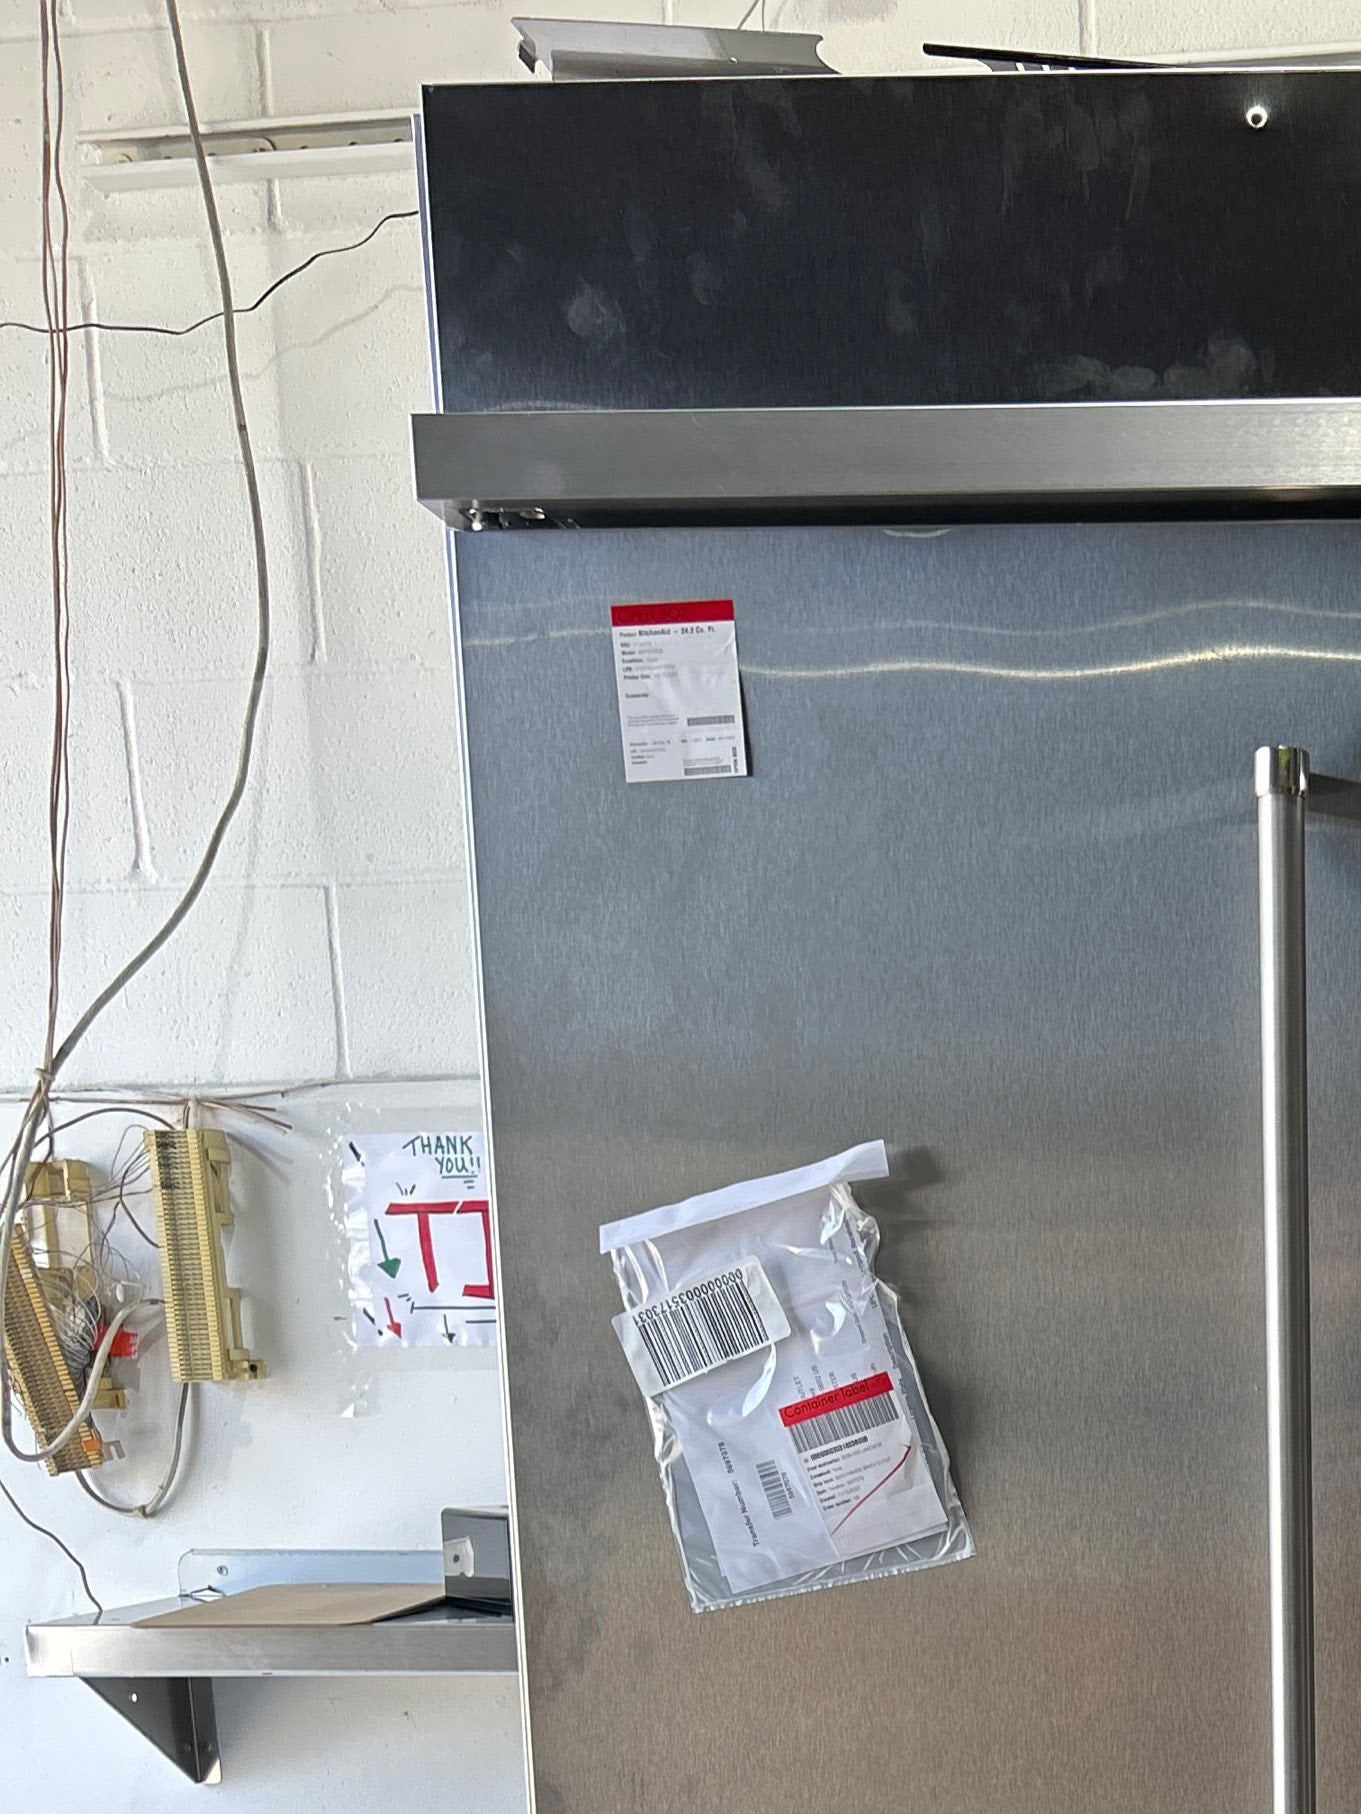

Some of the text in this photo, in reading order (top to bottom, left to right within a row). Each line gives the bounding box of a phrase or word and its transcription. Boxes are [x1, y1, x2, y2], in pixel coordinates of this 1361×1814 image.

[402, 1135, 473, 1157] THANK
[434, 1156, 481, 1175] YOU!!
[632, 1268, 743, 1327] 0000000035173031
[784, 1394, 840, 1418] Container
[840, 1380, 870, 1400] label
